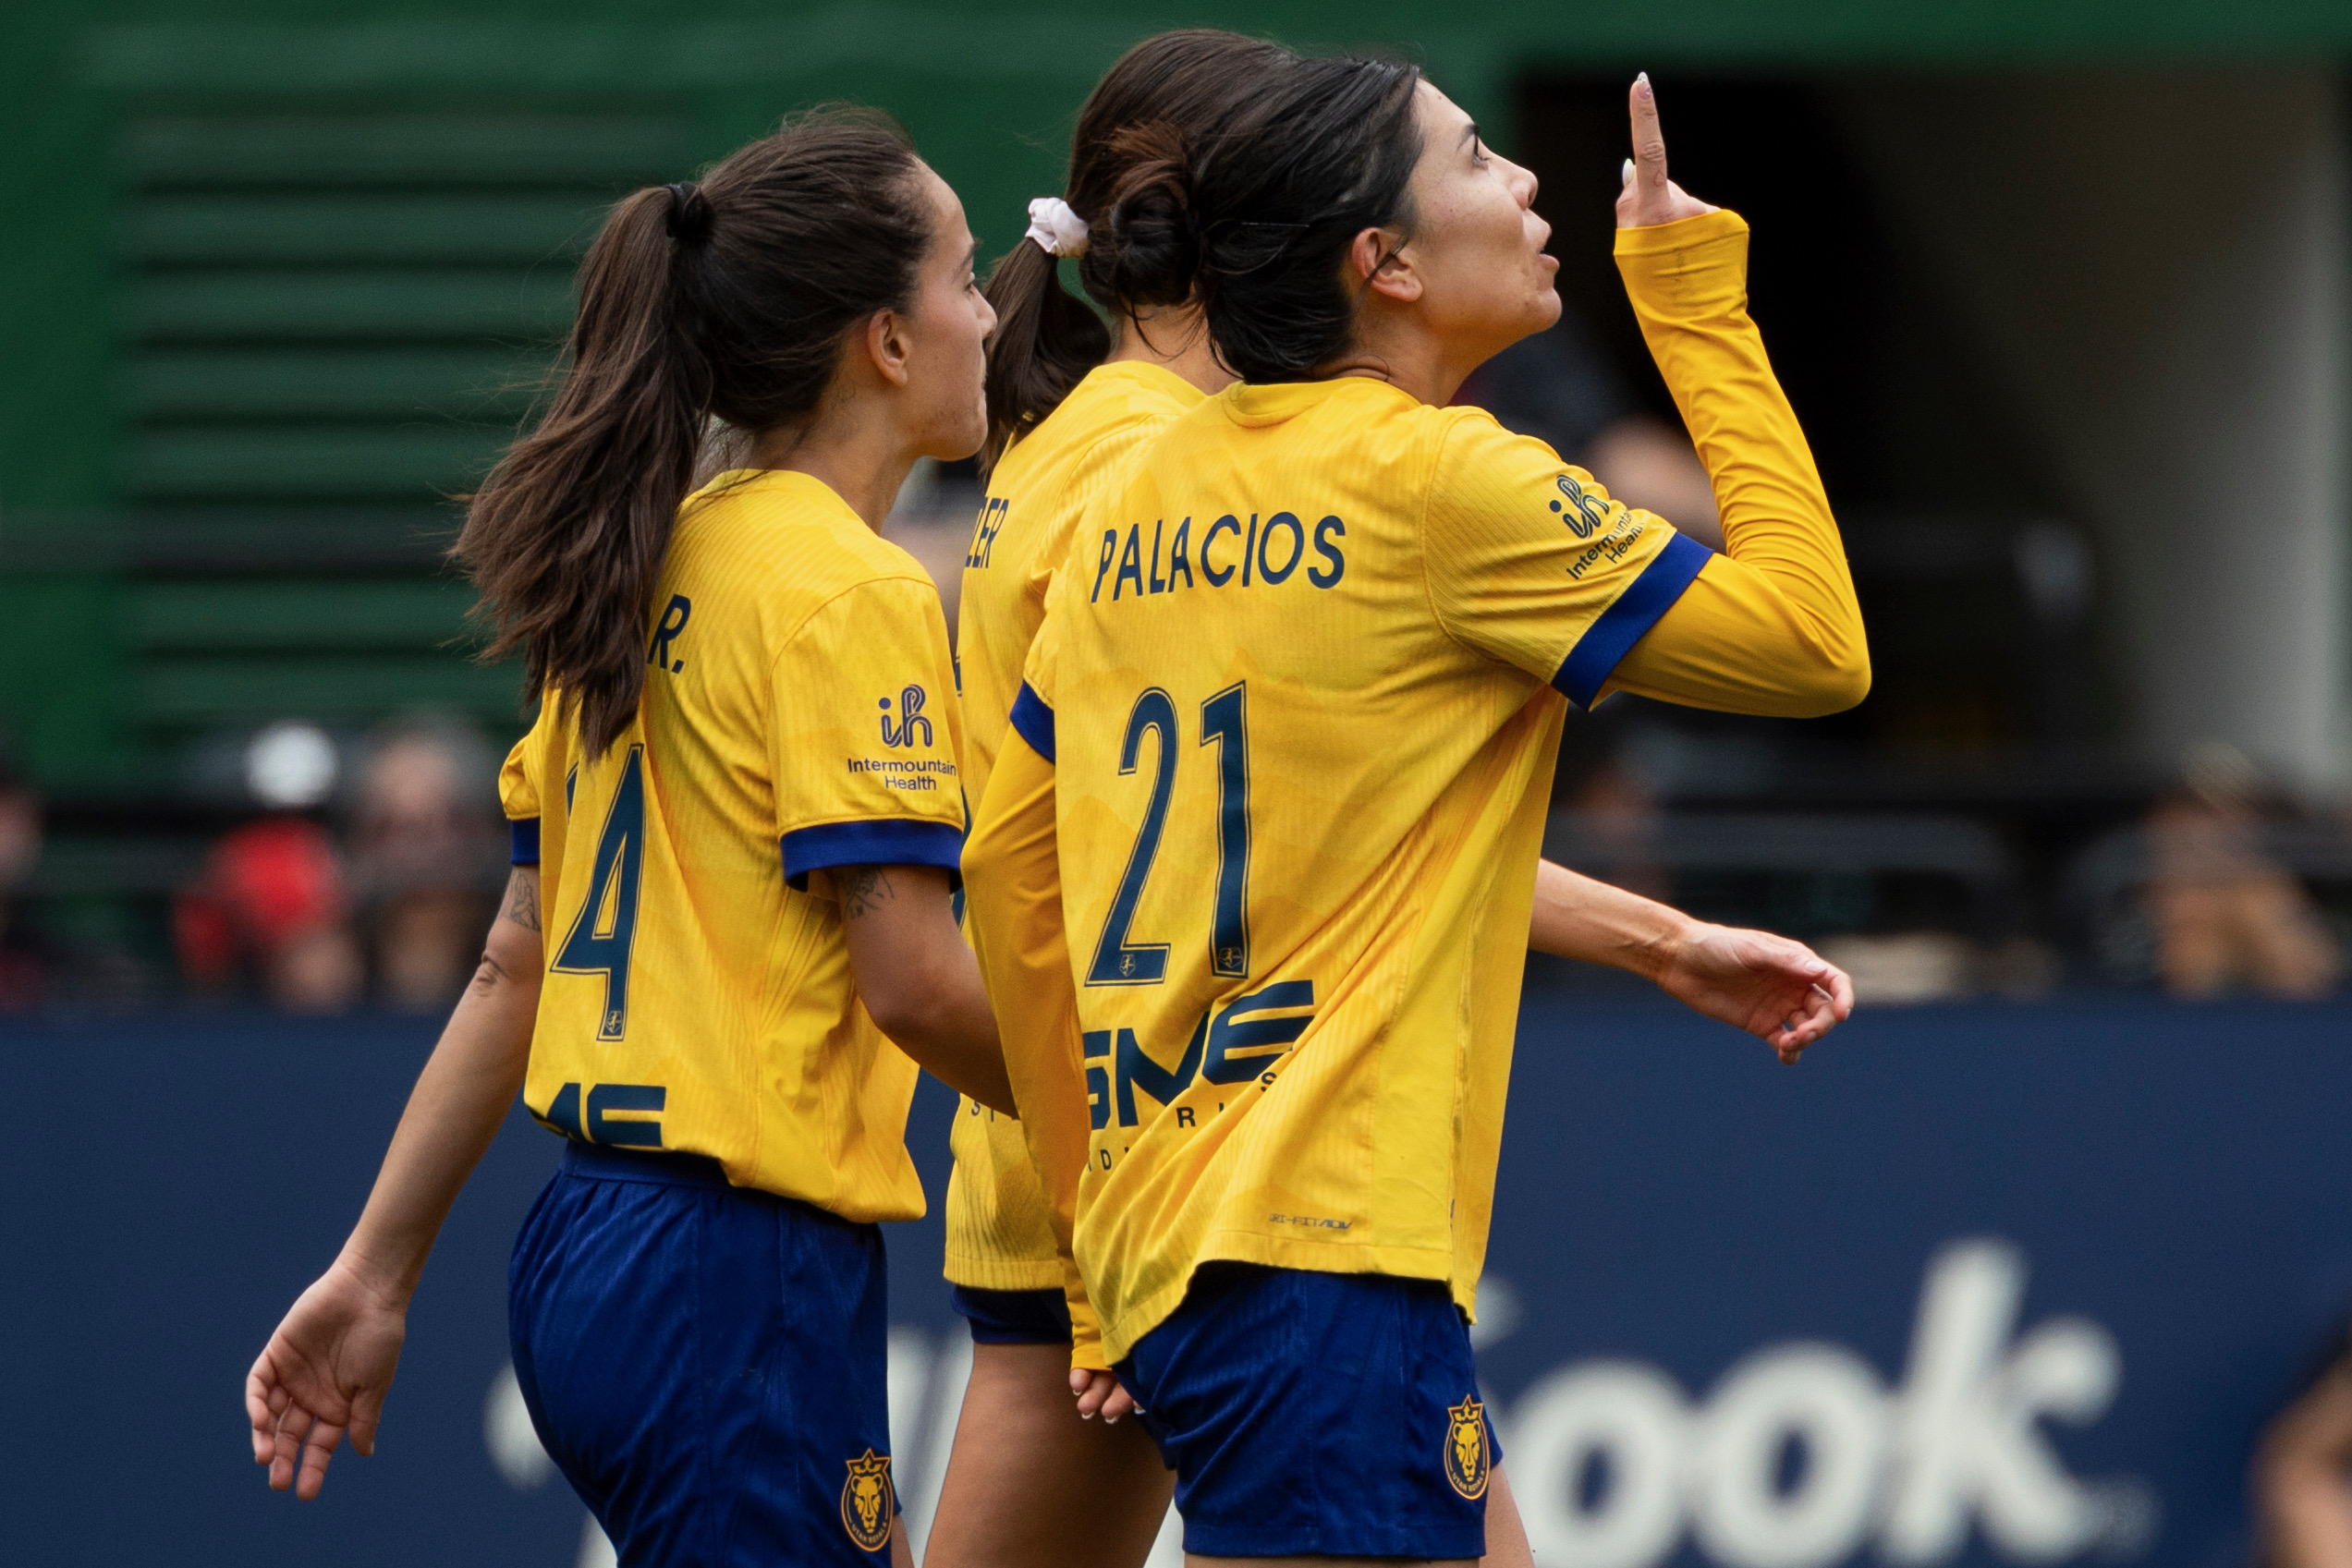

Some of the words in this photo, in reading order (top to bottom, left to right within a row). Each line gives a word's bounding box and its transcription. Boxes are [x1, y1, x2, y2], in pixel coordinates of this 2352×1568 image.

[1091, 511, 1347, 603] PALACIOS
[647, 594, 691, 675] R.
[847, 758, 957, 776] Intermountain
[884, 775, 937, 791] Health
[1084, 679, 1251, 988] 21
[550, 743, 646, 1042] 4
